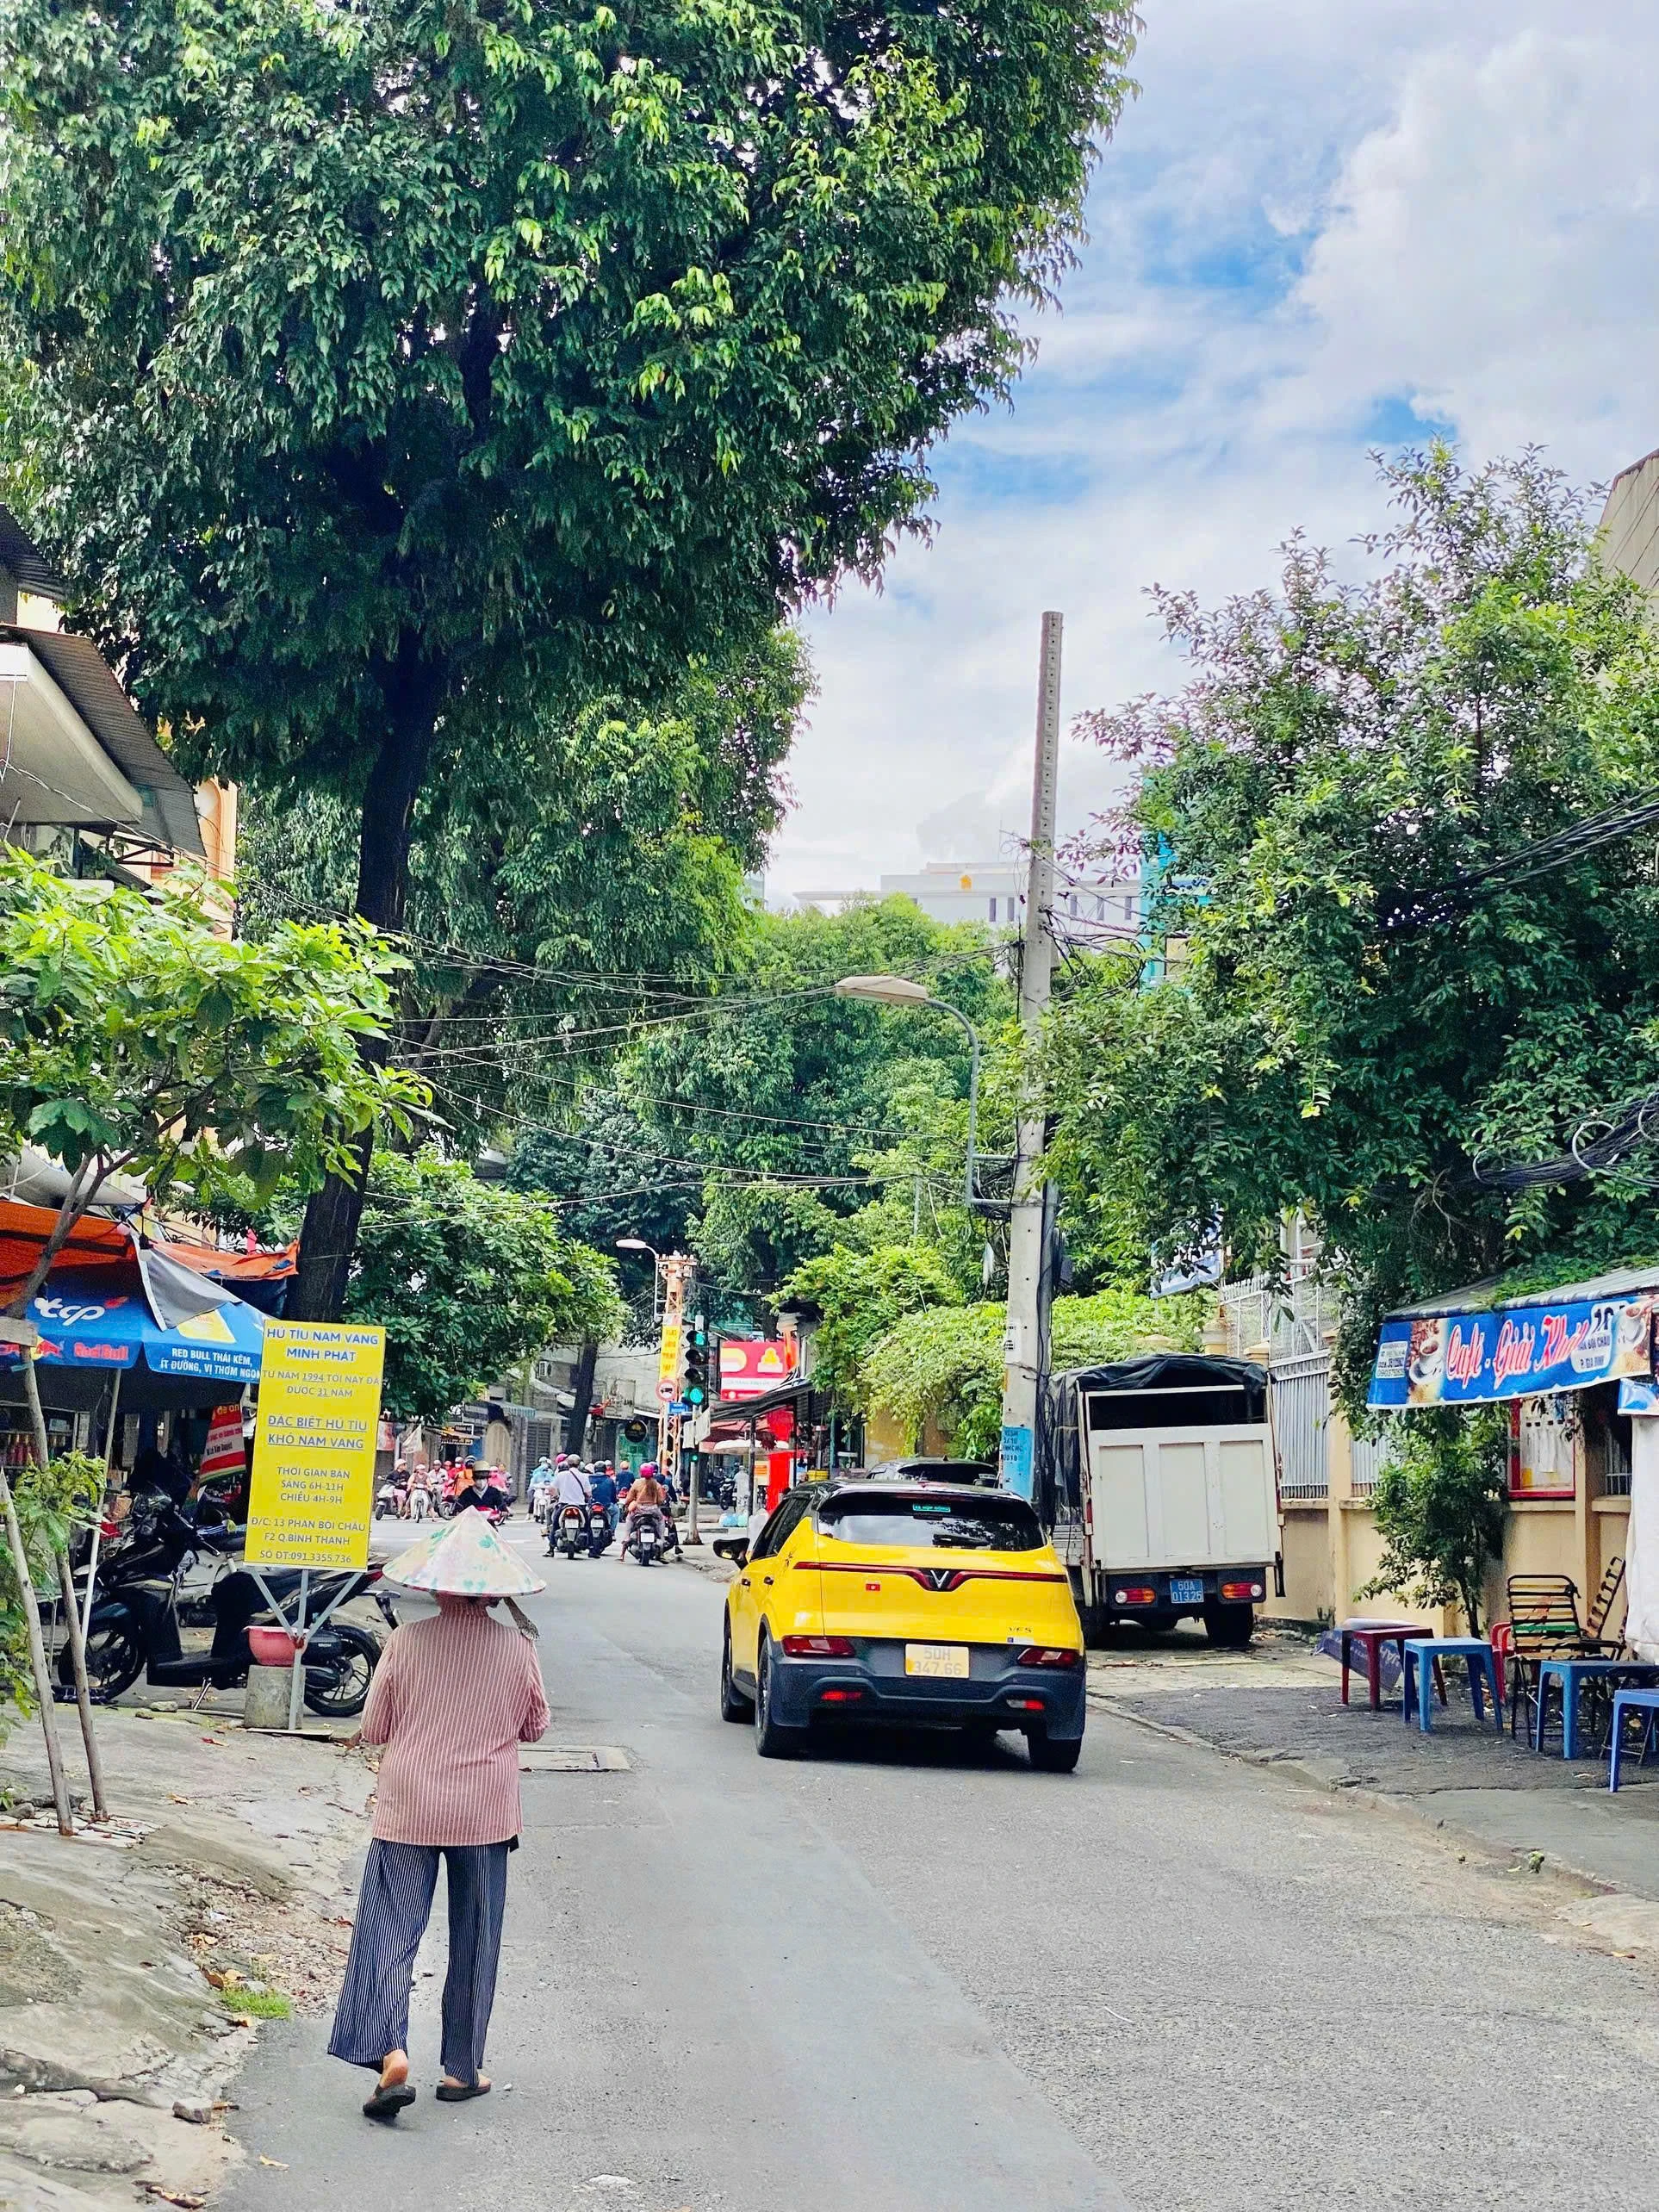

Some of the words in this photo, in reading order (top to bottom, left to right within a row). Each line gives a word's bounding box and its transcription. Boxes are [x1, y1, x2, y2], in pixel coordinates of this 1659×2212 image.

[313, 1332, 340, 1342] NAM
[345, 1334, 378, 1345] VANG
[172, 1348, 188, 1358] RED
[190, 1350, 210, 1360] BULL
[287, 1348, 320, 1359] MINH
[302, 1373, 325, 1382] 1994
[299, 1435, 326, 1446] NAM
[331, 1437, 363, 1448] VANG
[303, 1468, 327, 1477] GIAN
[313, 1494, 343, 1504] 4H-9H
[252, 1517, 271, 1526] Đ/C:
[275, 1518, 285, 1527] 13
[288, 1519, 315, 1529] PHAN
[264, 1532, 275, 1541] F2
[923, 1646, 951, 1661] 50H
[913, 1661, 963, 1676] 347.66
